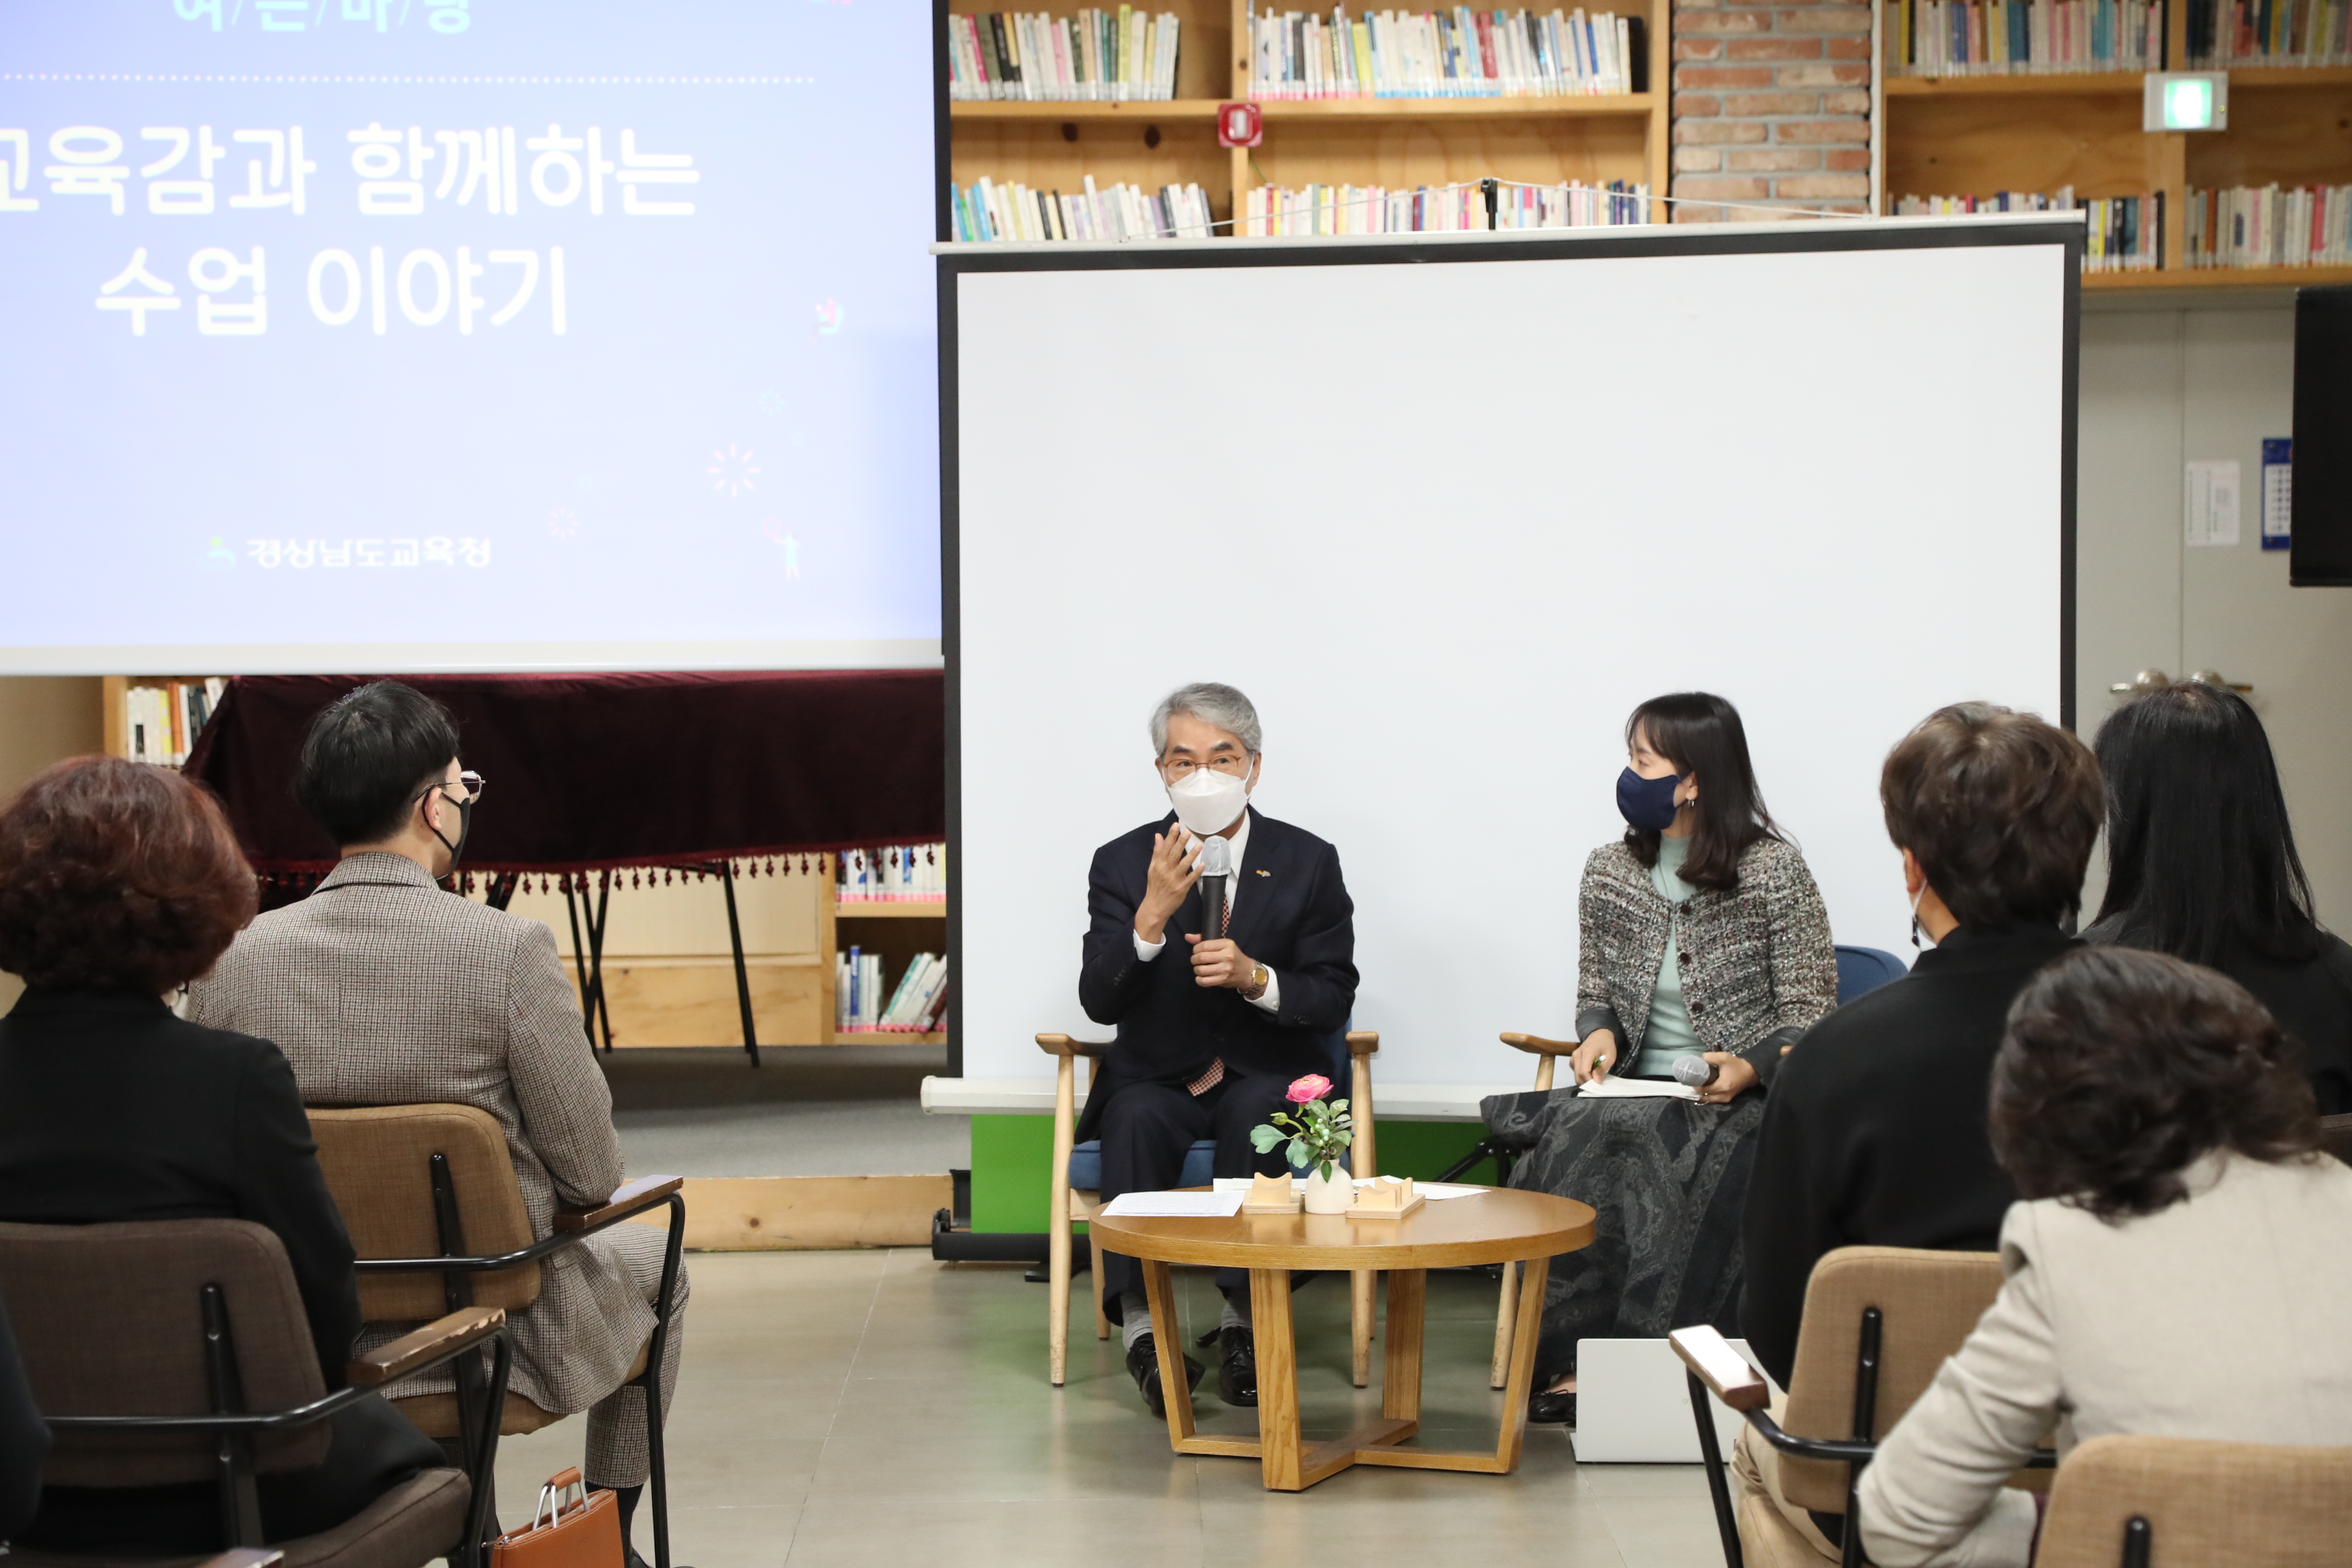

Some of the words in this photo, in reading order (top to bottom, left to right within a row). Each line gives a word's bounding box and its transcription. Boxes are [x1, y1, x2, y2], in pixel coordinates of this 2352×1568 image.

[347, 122, 700, 215] 함께하는
[95, 246, 267, 337] 수업
[307, 246, 566, 336] 이야기
[247, 535, 491, 569] 경상남도교육청
